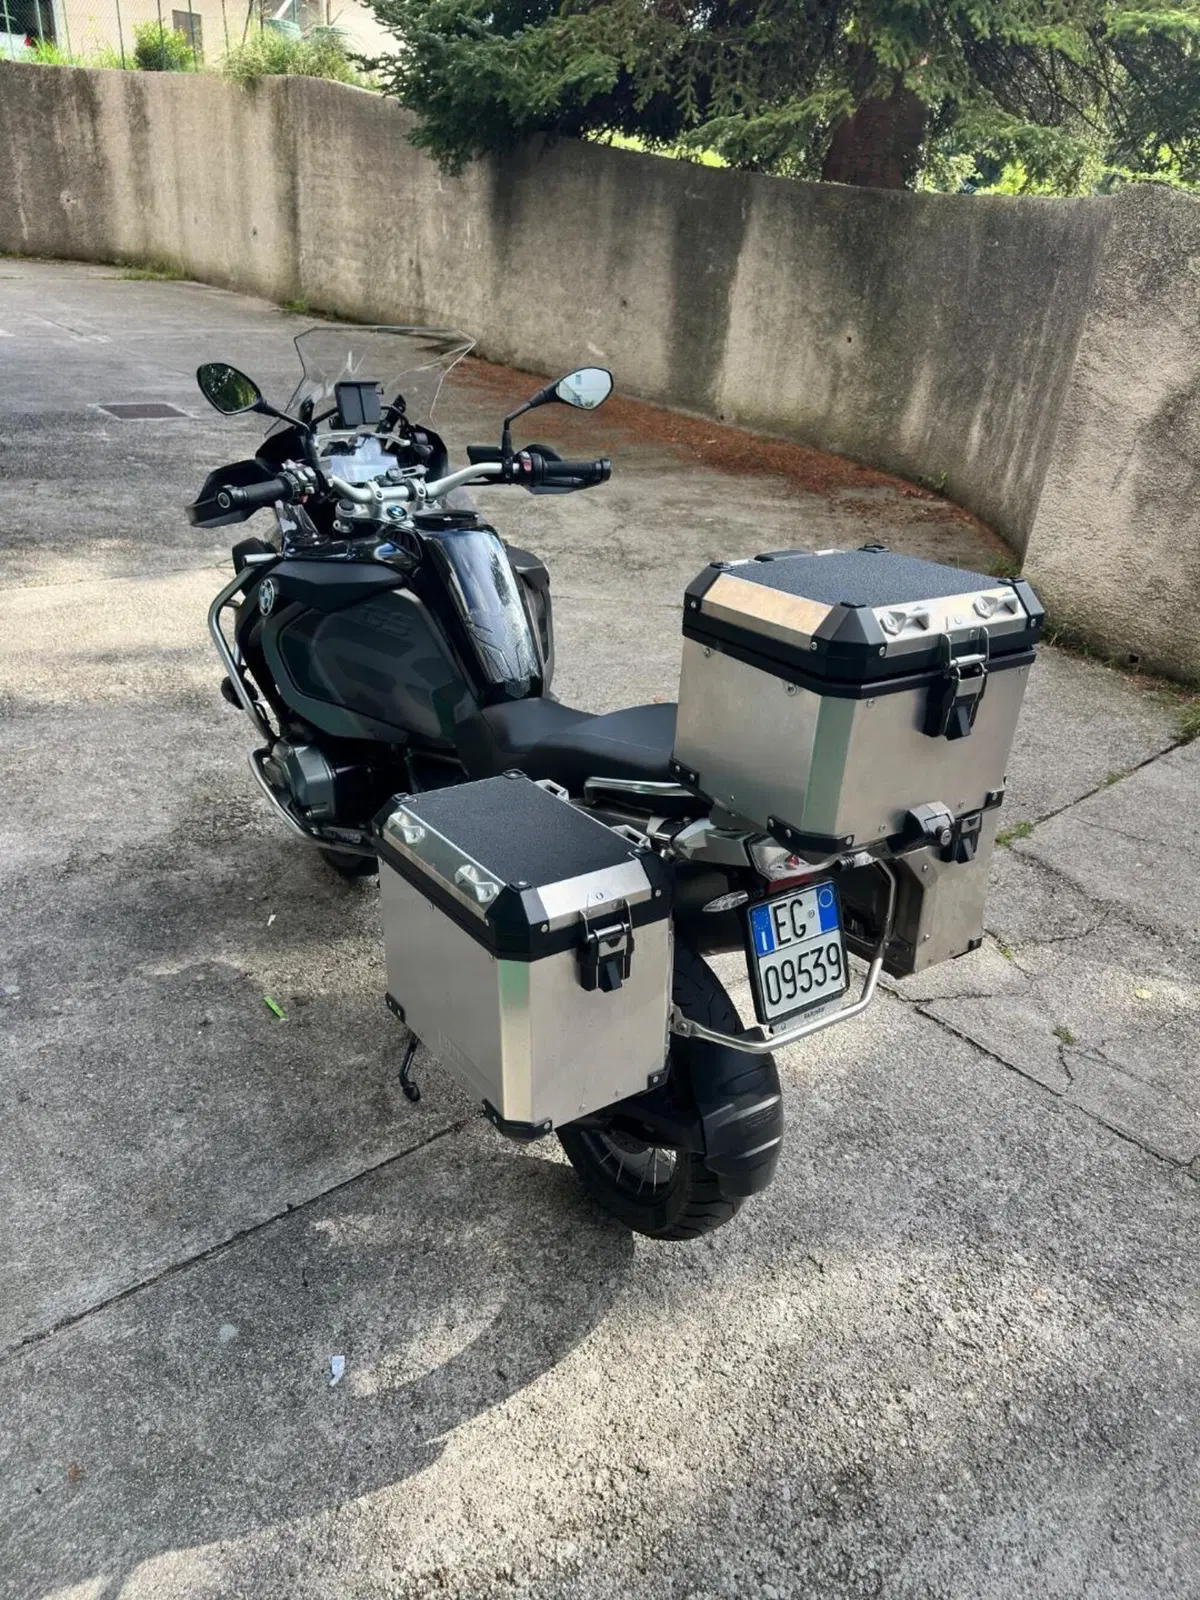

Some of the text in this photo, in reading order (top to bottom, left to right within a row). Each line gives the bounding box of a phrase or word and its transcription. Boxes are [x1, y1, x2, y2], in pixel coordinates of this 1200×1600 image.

[761, 899, 806, 951] I EG
[765, 942, 842, 1005] 09539
